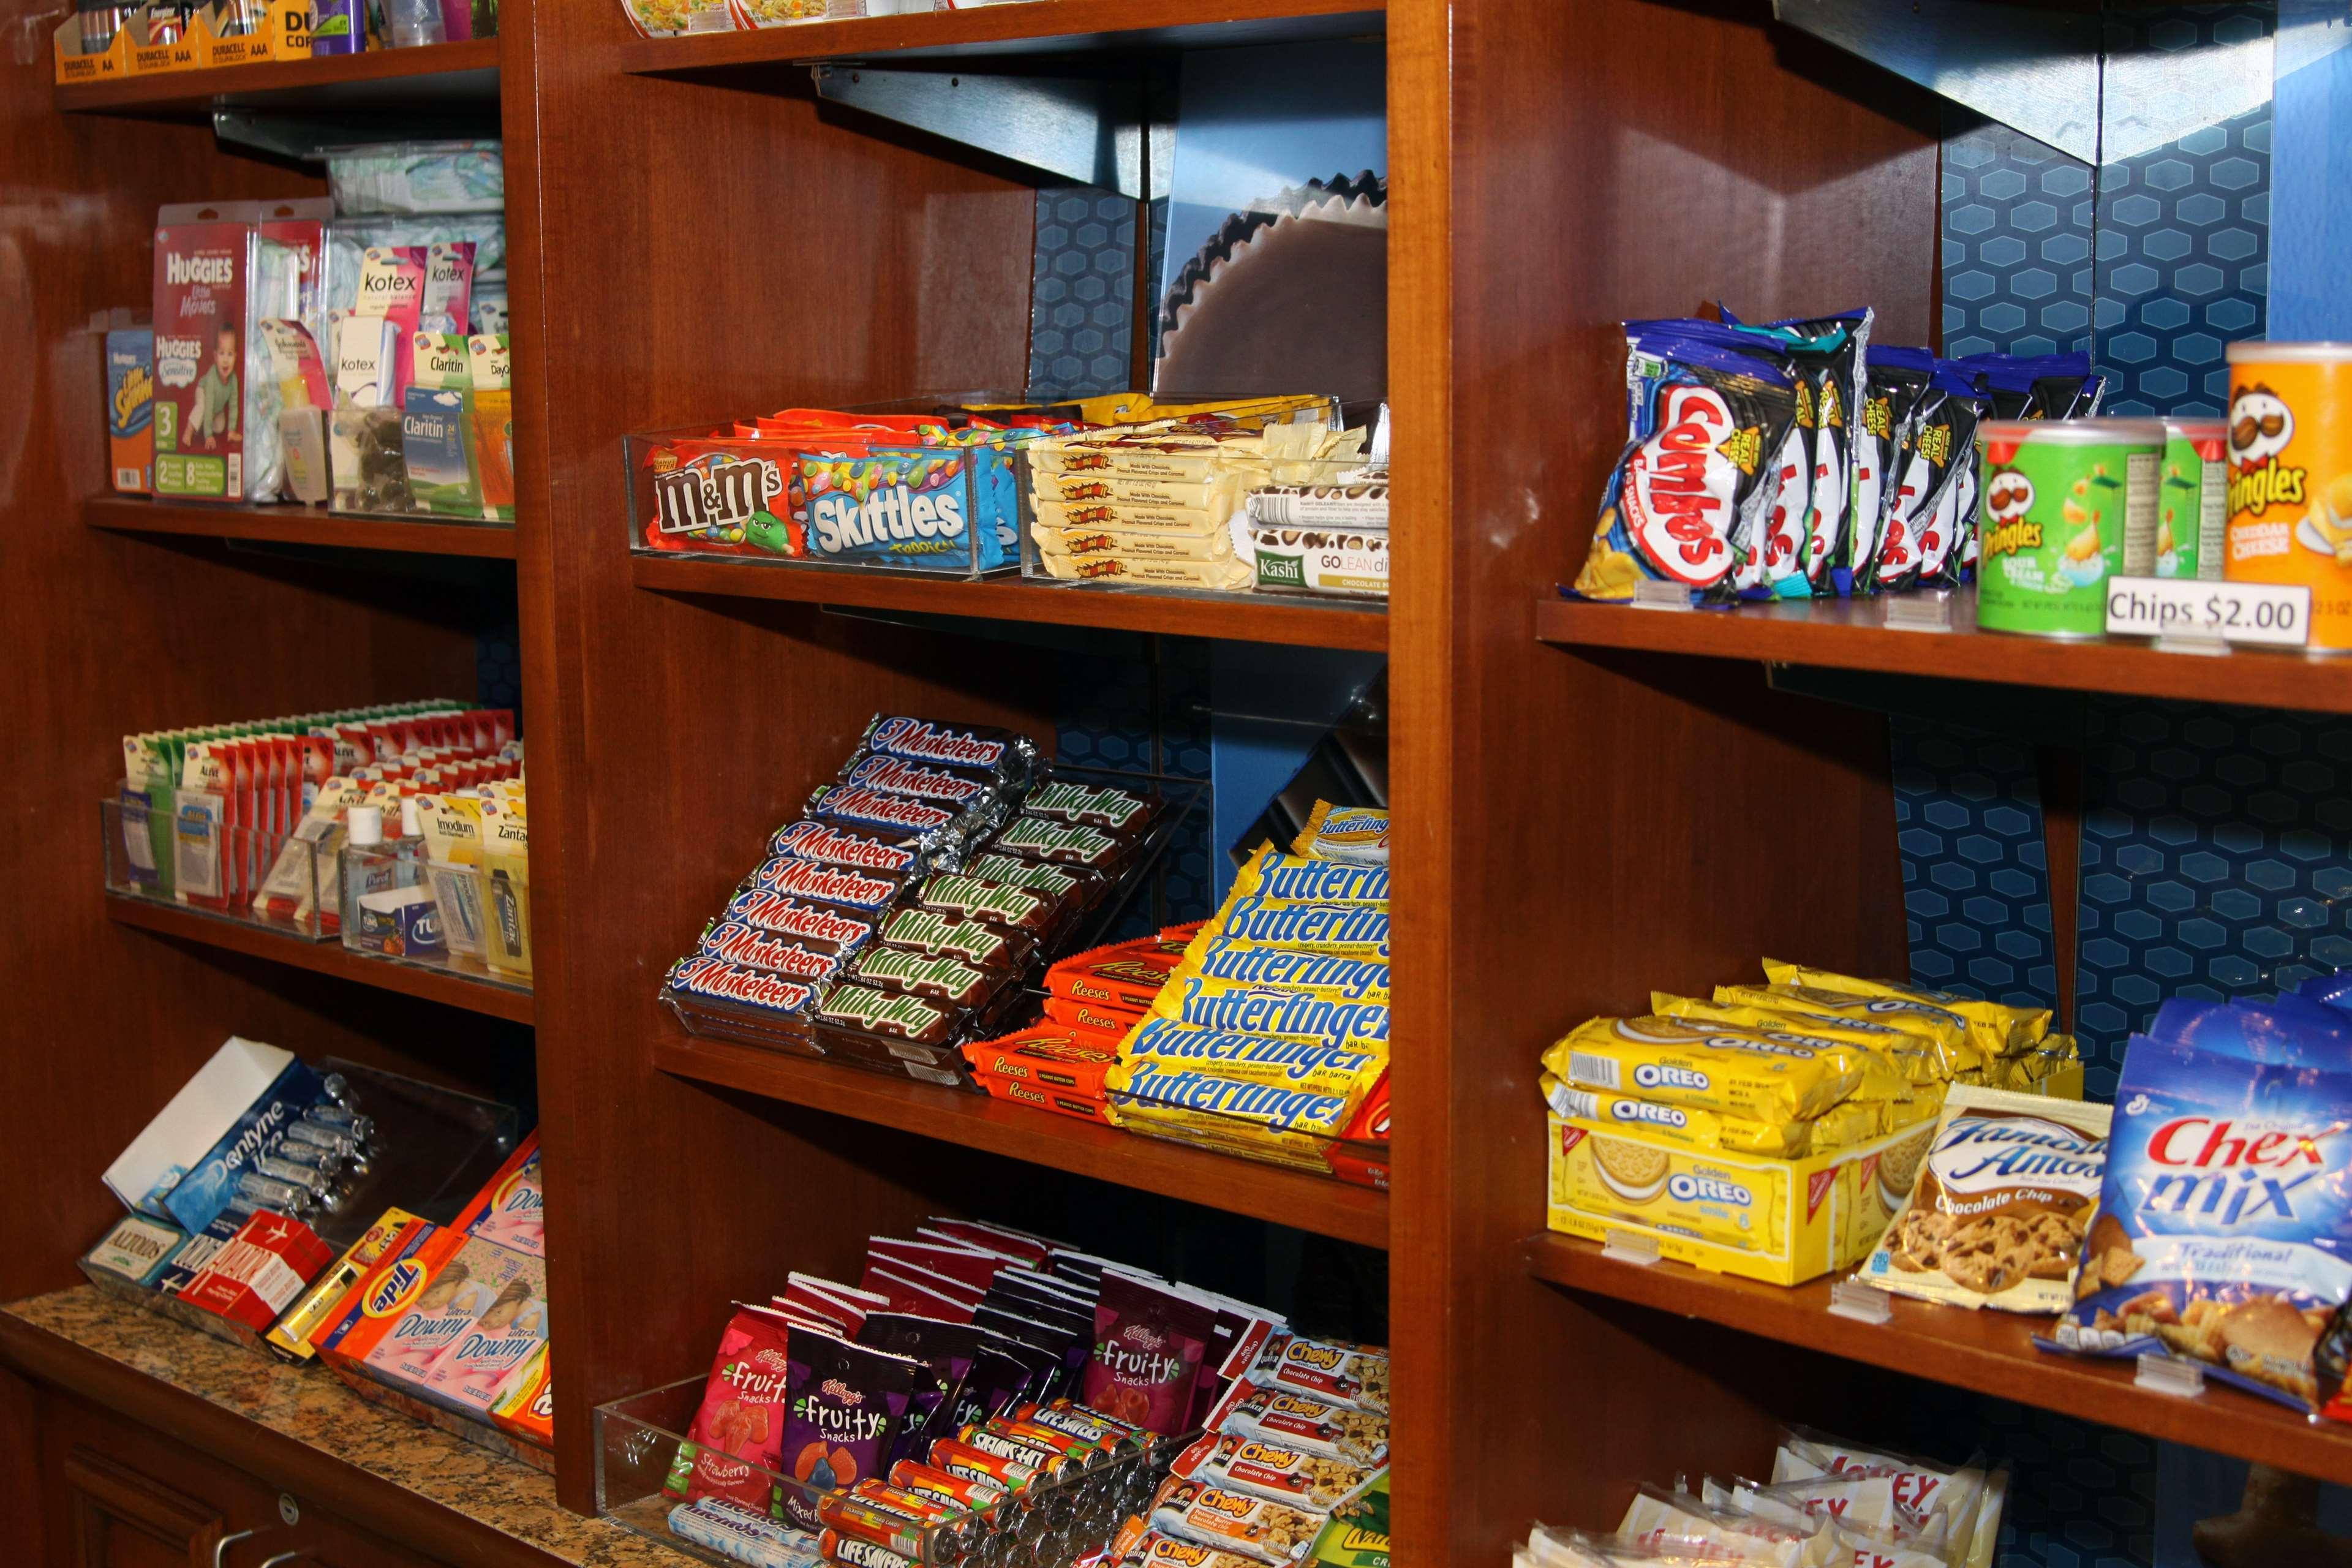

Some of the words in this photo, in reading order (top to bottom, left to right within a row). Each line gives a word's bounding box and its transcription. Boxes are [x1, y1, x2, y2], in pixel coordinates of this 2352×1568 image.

[137, 49, 169, 62] DURACELL
[175, 49, 191, 61] AAA
[212, 43, 245, 56] DURACELL
[251, 43, 268, 56] AAA
[102, 59, 115, 71] AA
[167, 252, 233, 285] HUGGIES
[432, 265, 464, 282] kotex
[364, 272, 416, 292] kotex
[157, 336, 202, 359] HUGGIES
[341, 357, 375, 371] kotex
[430, 356, 463, 373] Claritin
[160, 405, 172, 437] 3
[404, 417, 443, 439] Claritin
[1866, 398, 1877, 436] CHEESE
[1875, 404, 1886, 431] REAL
[1740, 434, 1751, 466] REAL
[1920, 425, 1933, 459] CHEESE
[1931, 429, 1942, 457] REAL
[159, 460, 168, 483] 2
[186, 461, 195, 486] 8
[1650, 396, 1724, 565] Combos
[813, 485, 964, 554] Skittles
[1260, 559, 1299, 579] Kashi
[1321, 555, 1372, 572] GOLEAN
[1342, 579, 1379, 589] CHOCOLATE
[2110, 591, 2193, 631] Chips
[2206, 600, 2295, 629] $2.00
[876, 720, 907, 741] 3
[889, 723, 1003, 765] Musketeers
[856, 758, 886, 778] 3
[867, 760, 981, 801] Musketeers
[825, 787, 854, 805] 3
[1027, 783, 1096, 821] Milky
[1088, 788, 1143, 826] Way
[835, 789, 952, 828] Musketeers
[437, 818, 474, 834] Imodium
[780, 825, 812, 843] 3
[794, 828, 913, 869] Musketeers
[1001, 817, 1068, 857] Milky
[1061, 826, 1115, 862] Way
[761, 859, 791, 879] 3
[775, 859, 895, 905] Musketeers
[736, 892, 766, 913] 3
[925, 875, 993, 918] Milky
[983, 884, 1039, 924] Way
[505, 894, 517, 946] Zantac
[748, 895, 870, 945] Musketeers
[708, 925, 738, 948] 3
[886, 909, 957, 954] Milky
[946, 920, 1003, 964] Way
[720, 928, 835, 977] Musketeers
[678, 959, 710, 978] 3
[859, 948, 931, 990] Milky
[925, 957, 983, 999] Way
[690, 960, 811, 1009] Musketeers
[1071, 979, 1110, 1000] Reese's
[821, 985, 895, 1028] Milky
[884, 994, 942, 1038] Way
[1077, 1009, 1115, 1030] Reese's
[1757, 1019, 1787, 1030] Golden
[1131, 1017, 1378, 1079] Butterfinger
[1705, 1036, 1815, 1059] OREO
[994, 1057, 1028, 1078] Reese's
[1659, 1056, 1693, 1068] Golden
[1635, 1064, 1709, 1090] OREO
[1009, 1082, 1045, 1103] Reese's
[1611, 1099, 1687, 1128] OREO
[206, 1101, 284, 1190] Dentyne
[2147, 1117, 2340, 1168] Chex
[1693, 1164, 1732, 1180] Golden
[1949, 1145, 2105, 1180] Amos
[1668, 1173, 1752, 1207] OREO
[1936, 1192, 2011, 1216] Chocolate
[2015, 1188, 2052, 1203] Chip
[2142, 1168, 2320, 1226] mix
[2179, 1242, 2293, 1264] Traditional
[372, 1263, 421, 1314] Tide
[445, 1307, 472, 1317] ultra
[394, 1313, 472, 1346] Downy
[507, 1327, 536, 1338] ultra
[1123, 1324, 1164, 1351] Kellogg's
[455, 1333, 537, 1369] Downy
[1103, 1340, 1175, 1384] fruity
[1286, 1341, 1345, 1370] Chewy
[1114, 1371, 1150, 1387] Snacks
[1283, 1367, 1310, 1381] Chocolate
[1310, 1374, 1324, 1384] Chip
[737, 1390, 771, 1404] Snacks
[822, 1379, 863, 1406] Kellogg's
[805, 1395, 880, 1441] fruity
[1272, 1396, 1331, 1419] Chewy
[1076, 1412, 1093, 1423] FLAVORS
[1100, 1423, 1112, 1431] HARD
[1112, 1427, 1127, 1436] CANDY
[1266, 1415, 1293, 1427] Chocolate
[1293, 1422, 1306, 1431] Chip
[820, 1428, 856, 1443] Snacks
[701, 1453, 750, 1477] Strawberry
[1240, 1442, 1301, 1469] Chewy
[1234, 1465, 1262, 1478] Chocolate
[788, 1495, 812, 1520] Mixed
[889, 1488, 908, 1498] FLAVORS
[928, 1501, 943, 1510] CANDY
[1166, 1498, 1191, 1507] QUAKER
[1199, 1488, 1258, 1518] Chewy
[846, 1507, 866, 1517] FLAVORS
[873, 1515, 885, 1523] HARD
[885, 1518, 900, 1528] CANDY
[1191, 1514, 1217, 1527] Chocolate
[1218, 1521, 1229, 1530] Chip
[1194, 1509, 1213, 1520] Peanut
[1214, 1514, 1233, 1526] Butter
[1125, 1549, 1147, 1559] QUAKER
[1155, 1539, 1211, 1567] Chewy
